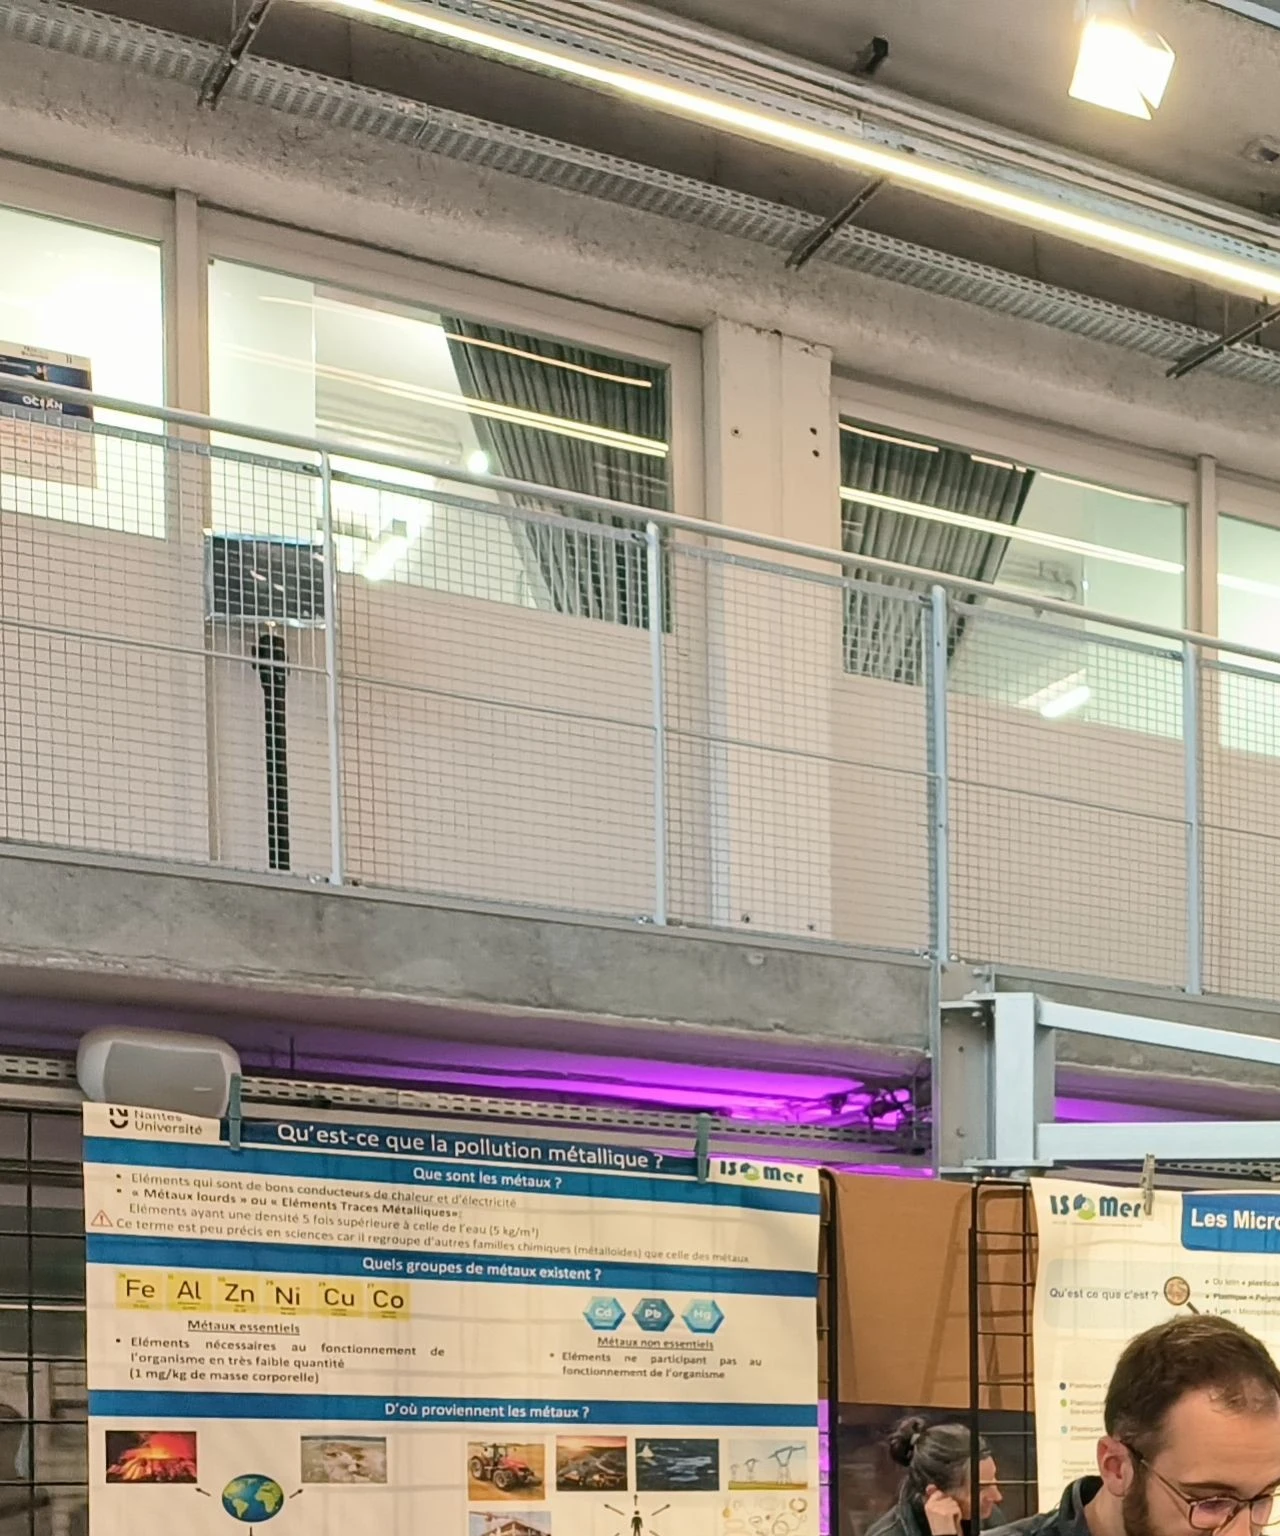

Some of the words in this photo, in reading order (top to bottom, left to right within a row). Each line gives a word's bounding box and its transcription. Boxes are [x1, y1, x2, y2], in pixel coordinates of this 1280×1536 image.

[135, 1121, 202, 1136] Université
[386, 1133, 424, 1152] que
[431, 1134, 447, 1152] la
[455, 1139, 542, 1161] pollution
[549, 1144, 648, 1169] métallique
[654, 1154, 663, 1168] ?
[414, 1168, 442, 1181] Que
[446, 1171, 474, 1182] sont
[479, 1173, 497, 1184] les
[501, 1173, 550, 1187] métaux
[554, 1177, 561, 1189] ?
[1190, 1209, 1228, 1228] Les
[362, 1257, 402, 1271] Quels
[406, 1262, 463, 1276] groupes
[466, 1262, 483, 1274] de
[487, 1263, 536, 1278] métaux
[540, 1265, 591, 1281] existent
[594, 1268, 601, 1281] ?
[126, 1279, 155, 1298] Fe
[177, 1281, 201, 1299] Al
[224, 1283, 254, 1303] Zn
[275, 1286, 301, 1305] Ni
[323, 1288, 355, 1307] Cu
[372, 1290, 404, 1308] Co
[1102, 1291, 1121, 1300] que
[595, 1307, 612, 1318] Cd
[645, 1308, 661, 1319] Pb
[188, 1320, 236, 1331] Métaux
[239, 1322, 300, 1334] essentiels
[597, 1337, 638, 1348] Métaux
[664, 1339, 714, 1350] essentiels
[130, 1368, 142, 1381] (1
[145, 1368, 187, 1382] mg/kg
[190, 1370, 206, 1381] de
[209, 1373, 248, 1382] masse
[252, 1371, 319, 1384] corporelle)
[422, 1404, 505, 1418] proviennent
[508, 1406, 526, 1418] les
[530, 1407, 578, 1419] métaux
[583, 1407, 590, 1418] ?
